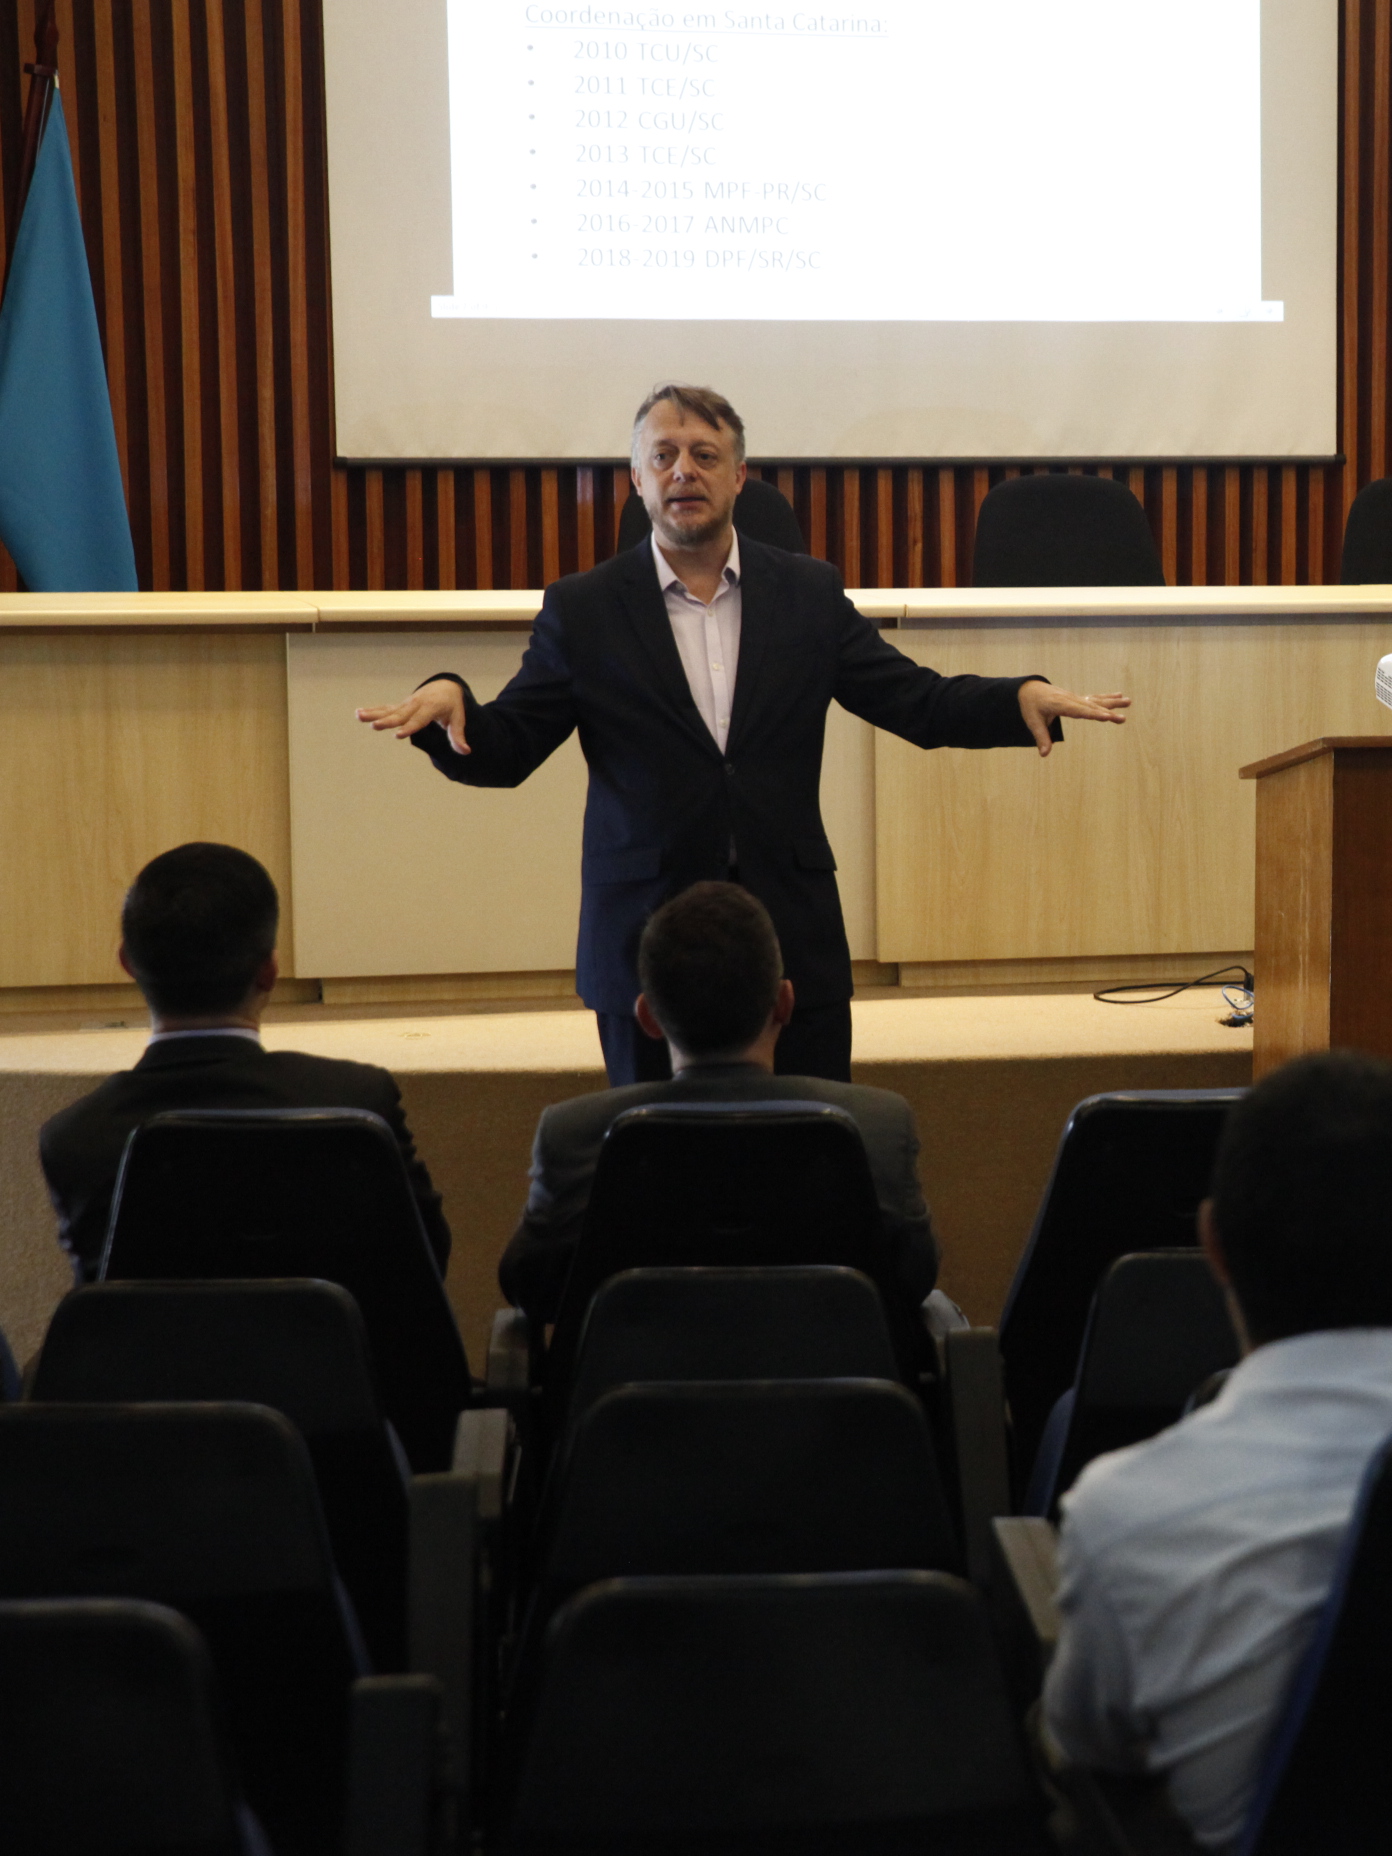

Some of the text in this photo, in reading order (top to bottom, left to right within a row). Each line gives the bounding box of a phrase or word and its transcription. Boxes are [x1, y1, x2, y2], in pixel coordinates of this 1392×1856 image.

[525, 4, 889, 33] Coordenação em Santa Catarina:
[573, 40, 719, 65] 2010 TCU/SC
[574, 75, 716, 100] 2011 TCE/SC
[574, 109, 724, 134] 2012 CGU/SC
[575, 144, 717, 168] 2013 TCE/SC
[576, 179, 828, 204] 2014-2015 MPF-PR/SC
[577, 213, 789, 235] 2016-2017 ANMPC
[577, 247, 822, 272] 2018-2019 DPF/SR/SC
